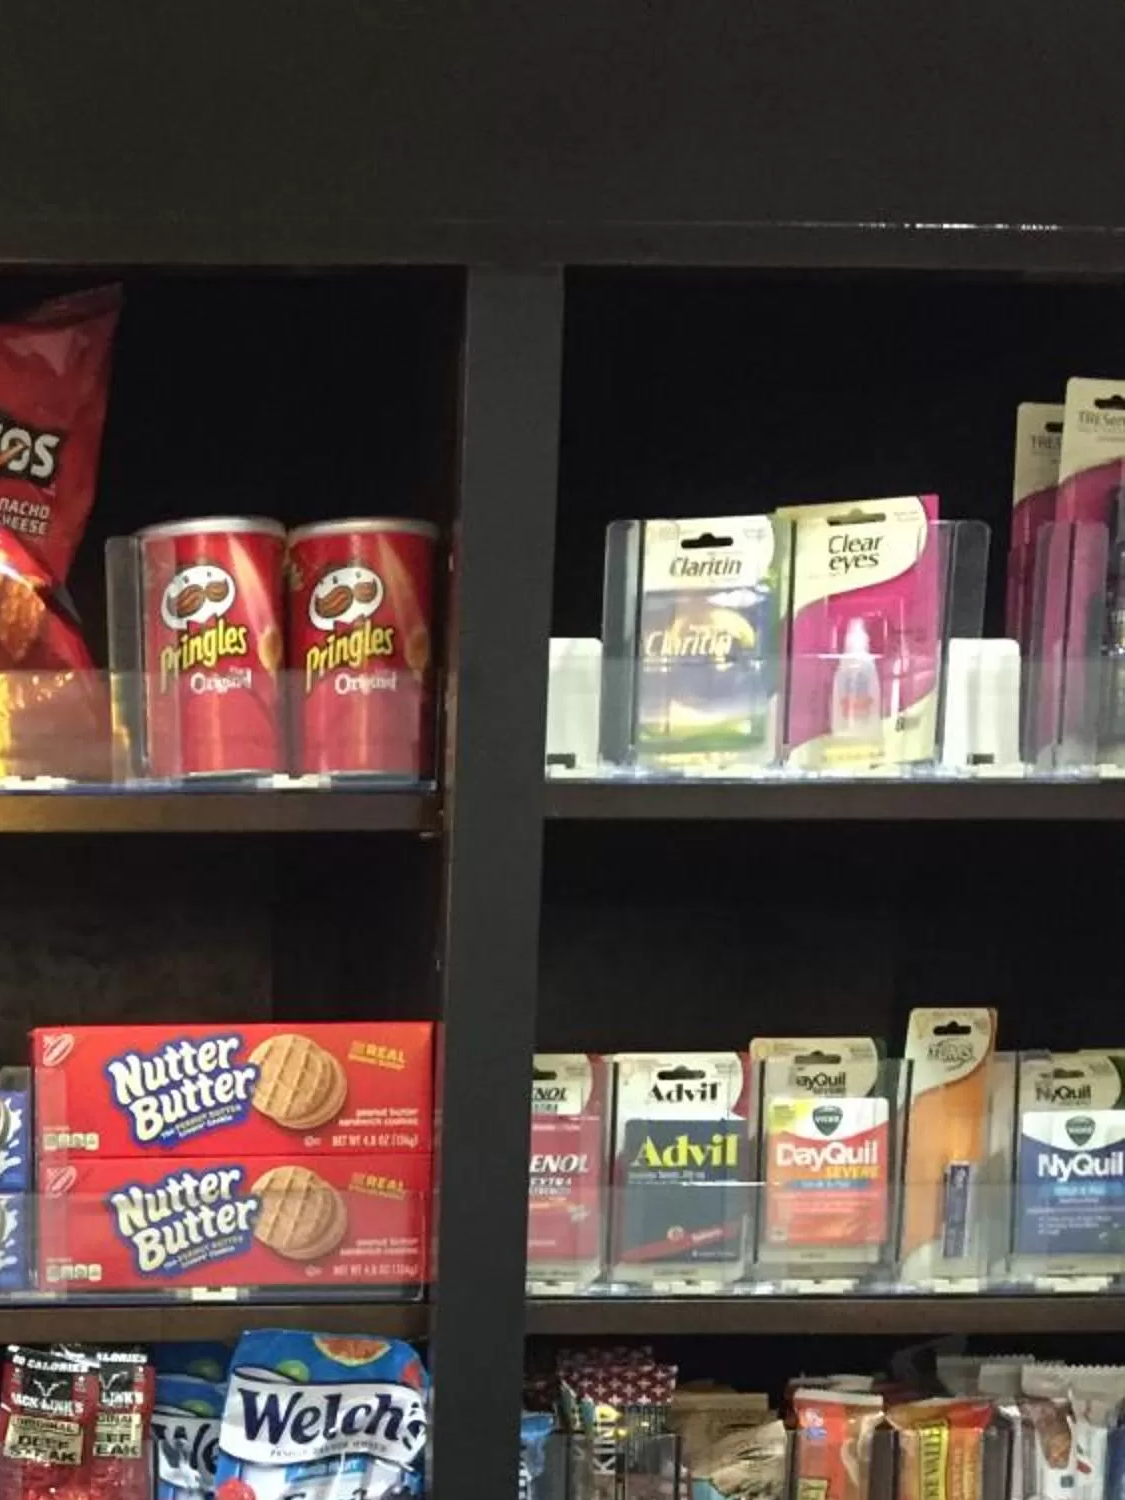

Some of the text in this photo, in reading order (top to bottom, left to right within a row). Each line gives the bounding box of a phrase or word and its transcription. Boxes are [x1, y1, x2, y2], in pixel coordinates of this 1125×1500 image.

[829, 533, 883, 556] Clear
[669, 557, 742, 577] Claritin
[829, 551, 879, 573] eyes
[160, 620, 248, 696] Pringles
[306, 620, 395, 694] Pringles
[108, 1036, 240, 1105] Nutter
[365, 1045, 405, 1063] REAL
[650, 1082, 720, 1103] Advil
[790, 1072, 847, 1090] ayQuil
[128, 1064, 256, 1141] Butter
[630, 1133, 740, 1168] Advil
[776, 1140, 879, 1172] DayQuil
[1038, 1152, 1124, 1184] NyQuil
[111, 1167, 242, 1235] Nutter
[131, 1195, 258, 1272] Butter
[237, 1388, 427, 1451] Welch's
